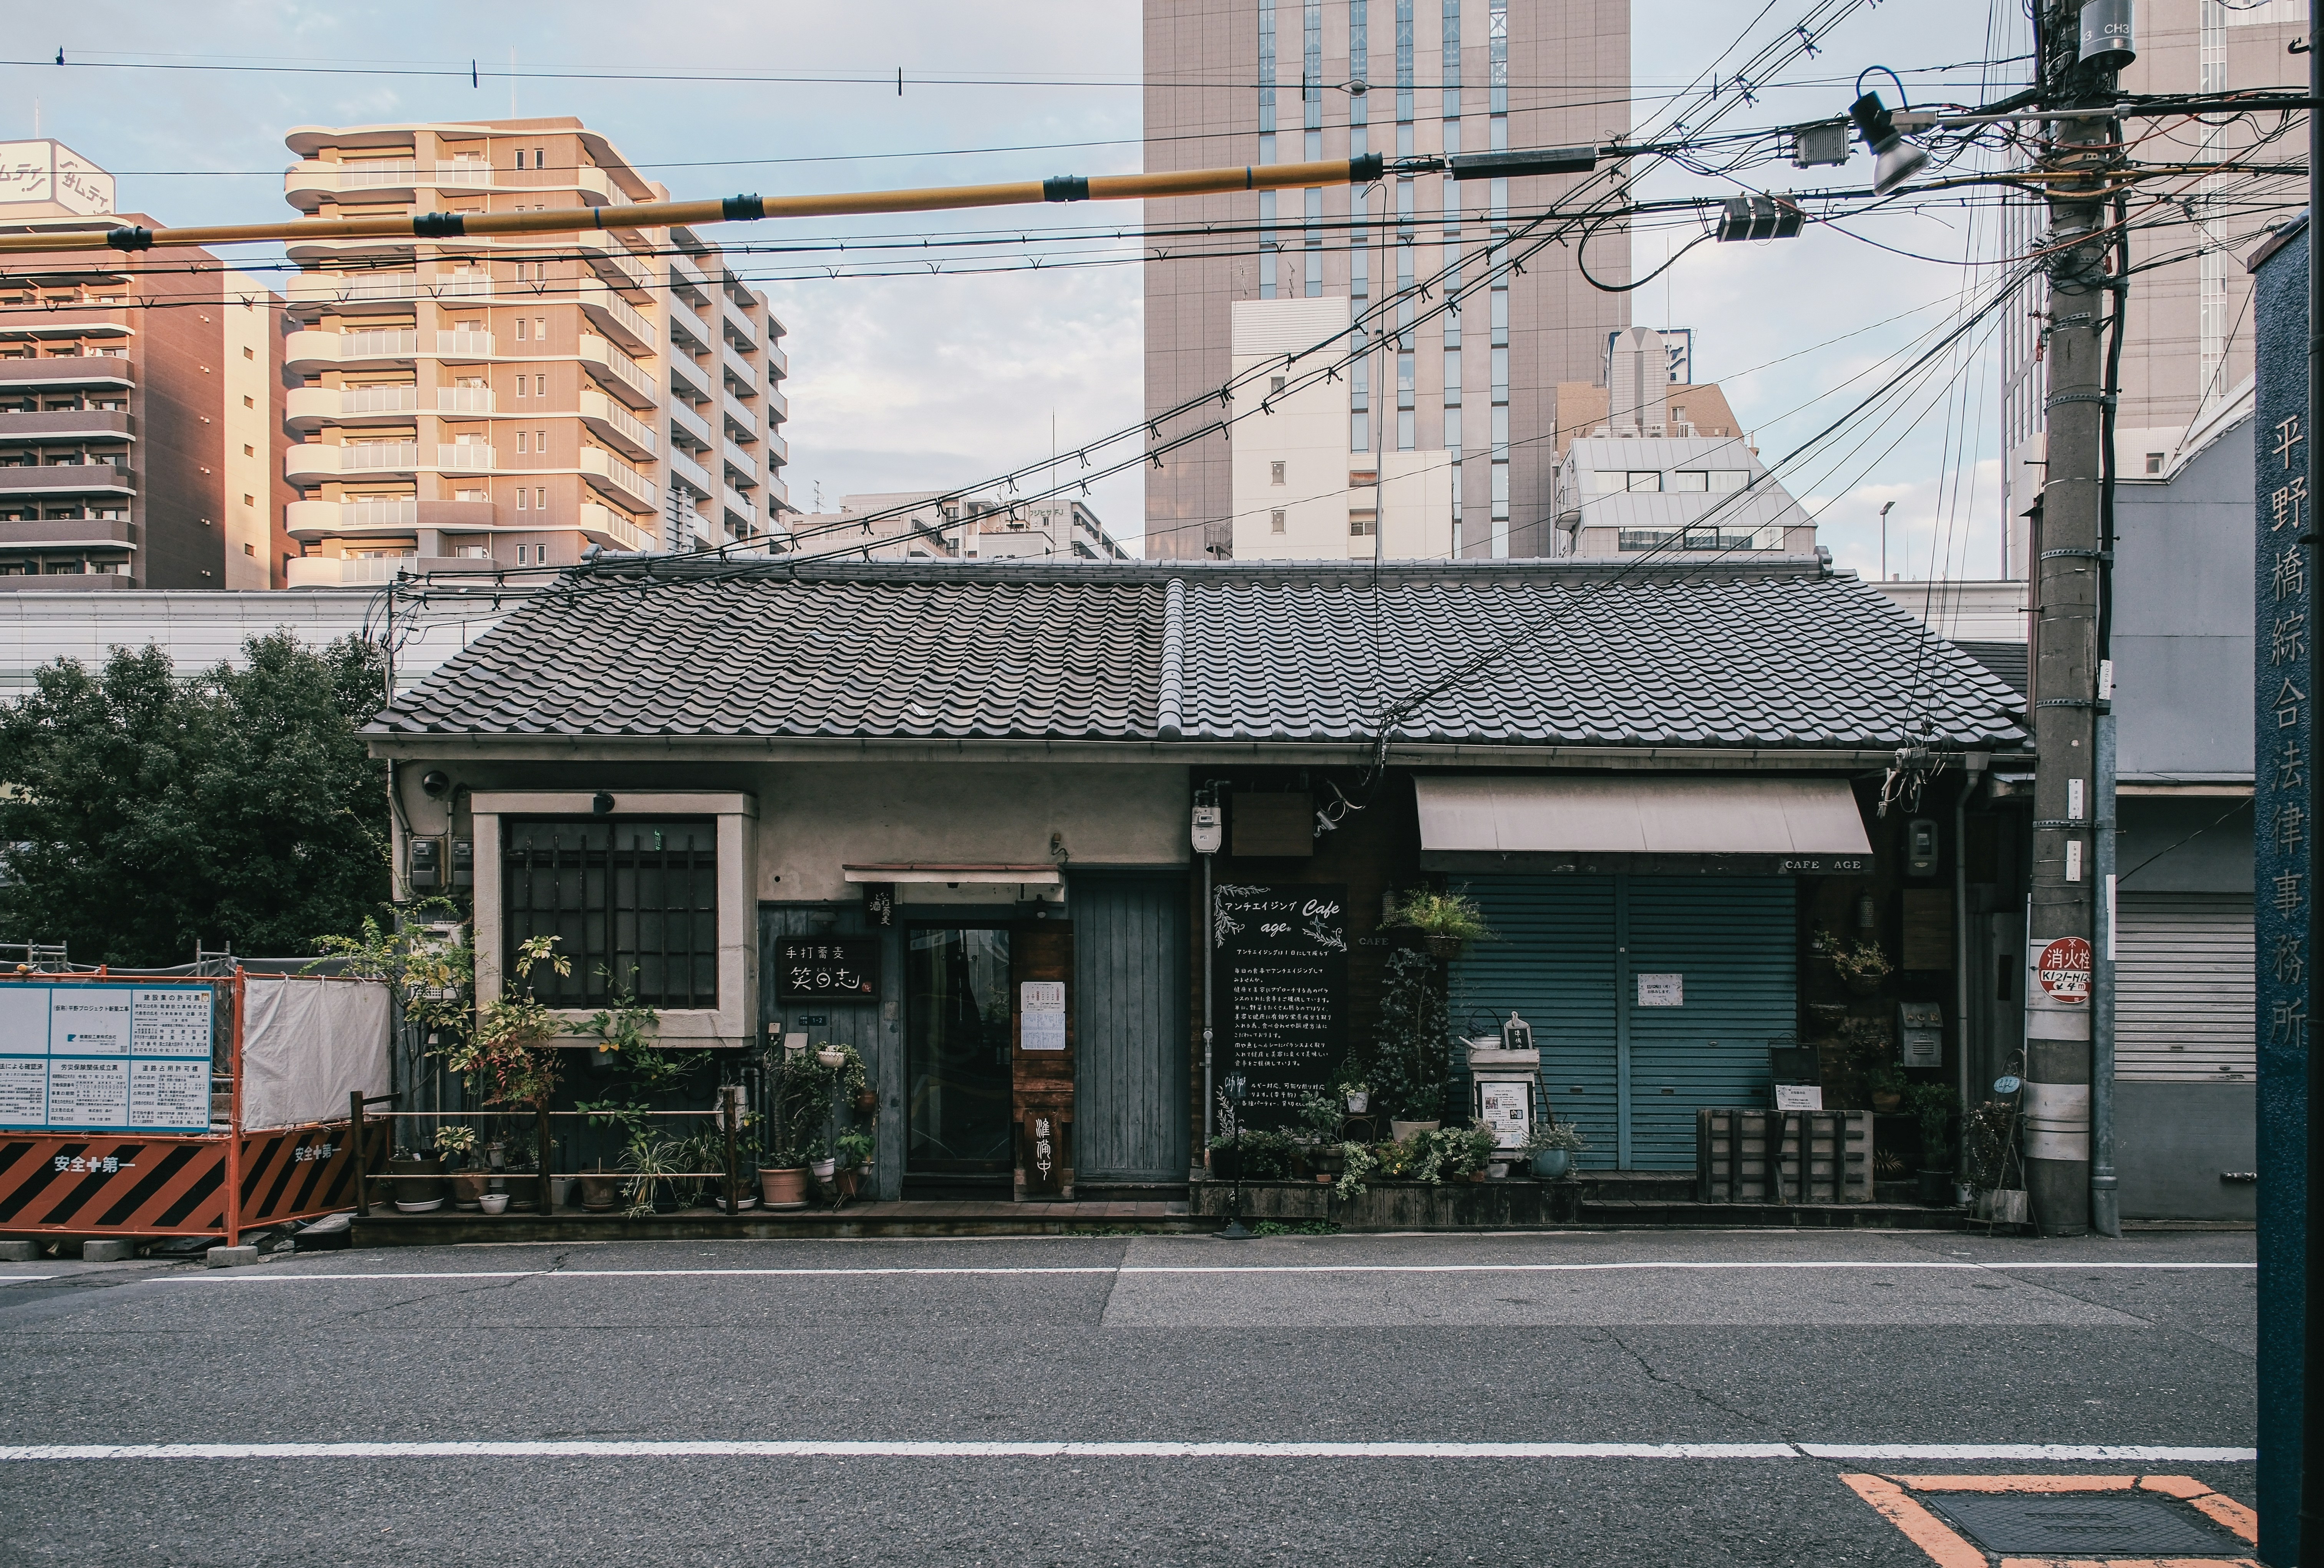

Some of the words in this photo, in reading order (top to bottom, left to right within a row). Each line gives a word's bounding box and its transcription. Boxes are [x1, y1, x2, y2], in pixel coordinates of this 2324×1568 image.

[2104, 24, 2130, 34] CH3
[2270, 414, 2307, 1048] 平野橋綜合法律事務所
[1834, 861, 1861, 869] AGE
[1225, 901, 1297, 911] アンチエイジング
[1302, 899, 1340, 919] Cafe
[1260, 922, 1287, 937] age
[786, 946, 844, 959] 手打蕎麦
[2047, 947, 2090, 969] 消火栓
[2043, 971, 2090, 982] K121-H12
[295, 1146, 313, 1162] 安全
[322, 1143, 342, 1158] 第一
[54, 1155, 86, 1173] 安全
[102, 1156, 136, 1173] 第一
